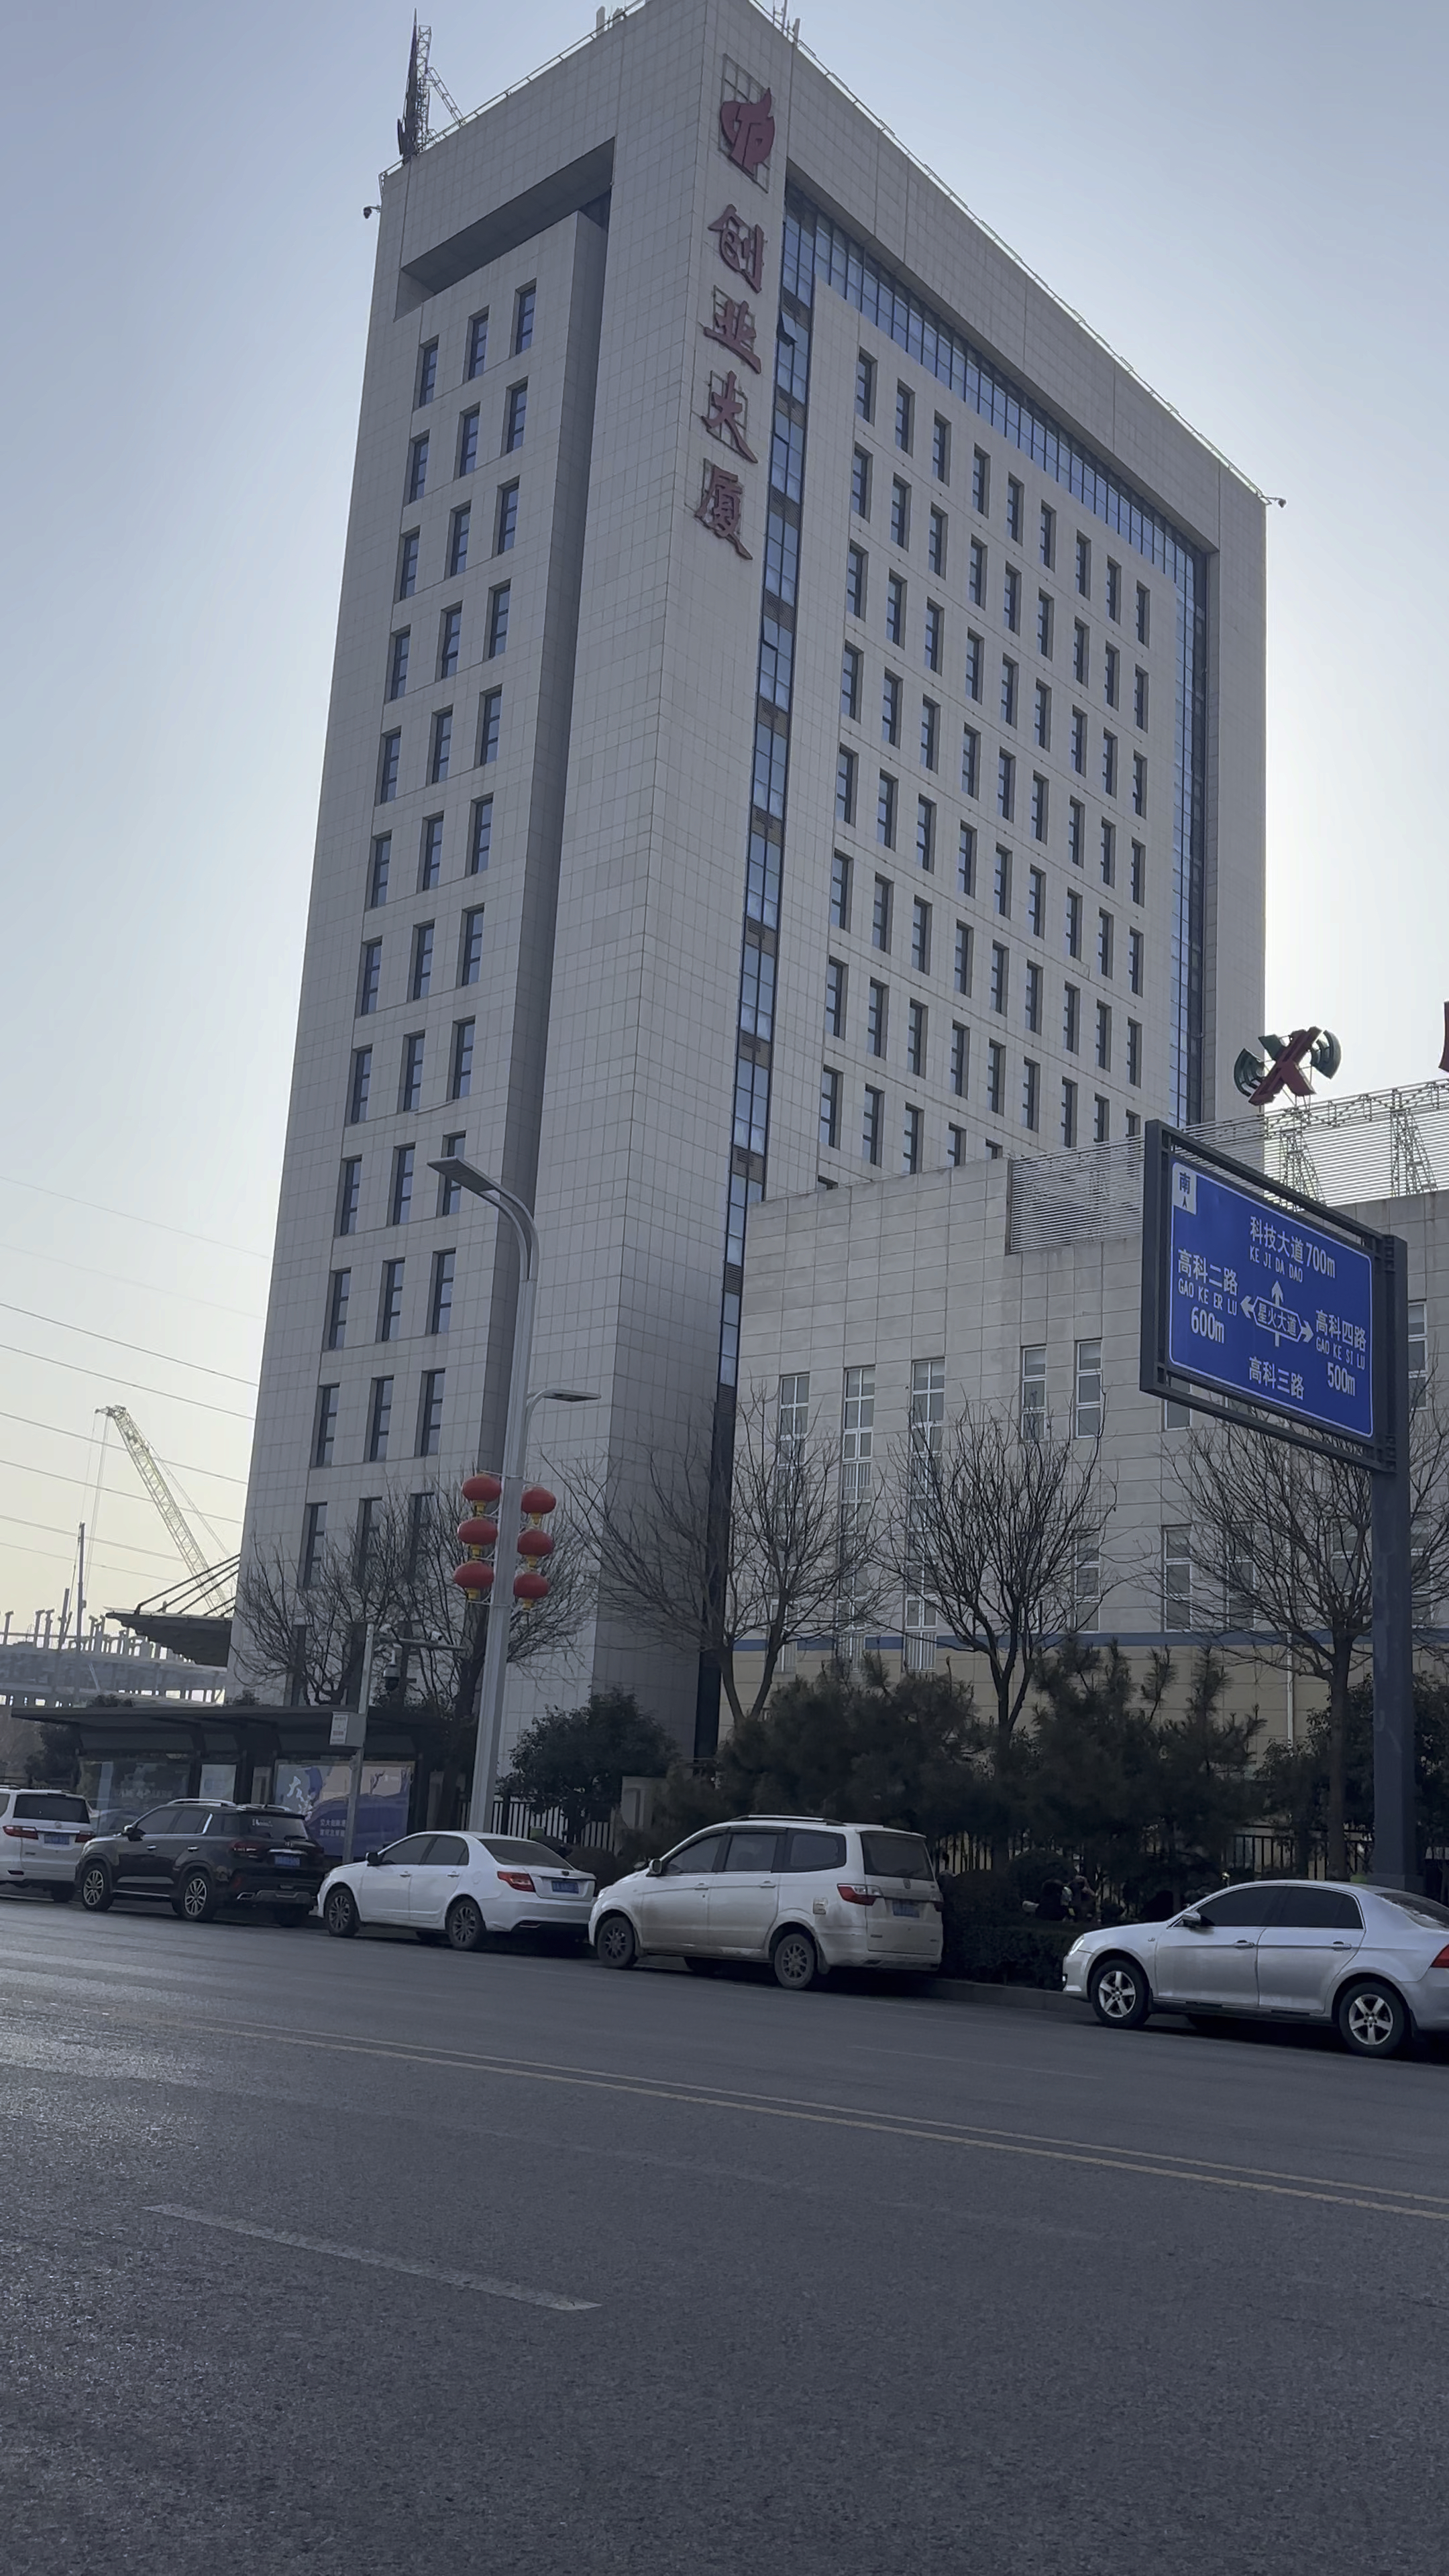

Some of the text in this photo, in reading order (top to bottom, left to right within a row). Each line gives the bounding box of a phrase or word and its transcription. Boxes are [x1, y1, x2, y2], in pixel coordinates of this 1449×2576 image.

[696, 205, 763, 560] 创业大厦
[1179, 1171, 1191, 1195] 南
[1250, 1216, 1304, 1264] 科技大道
[1177, 1248, 1238, 1296] 高科二路
[1250, 1246, 1303, 1283] KE JI DA DAO
[1306, 1242, 1336, 1279] 700m
[1178, 1279, 1237, 1316] GAO KE ER LU
[1191, 1307, 1225, 1344] 600m
[1257, 1303, 1297, 1337] 星火大道
[1316, 1309, 1366, 1352] 高科四路
[1316, 1336, 1365, 1370] GAO KE SI LU
[1249, 1356, 1304, 1400] 高科三路
[1328, 1362, 1355, 1397] 500m
